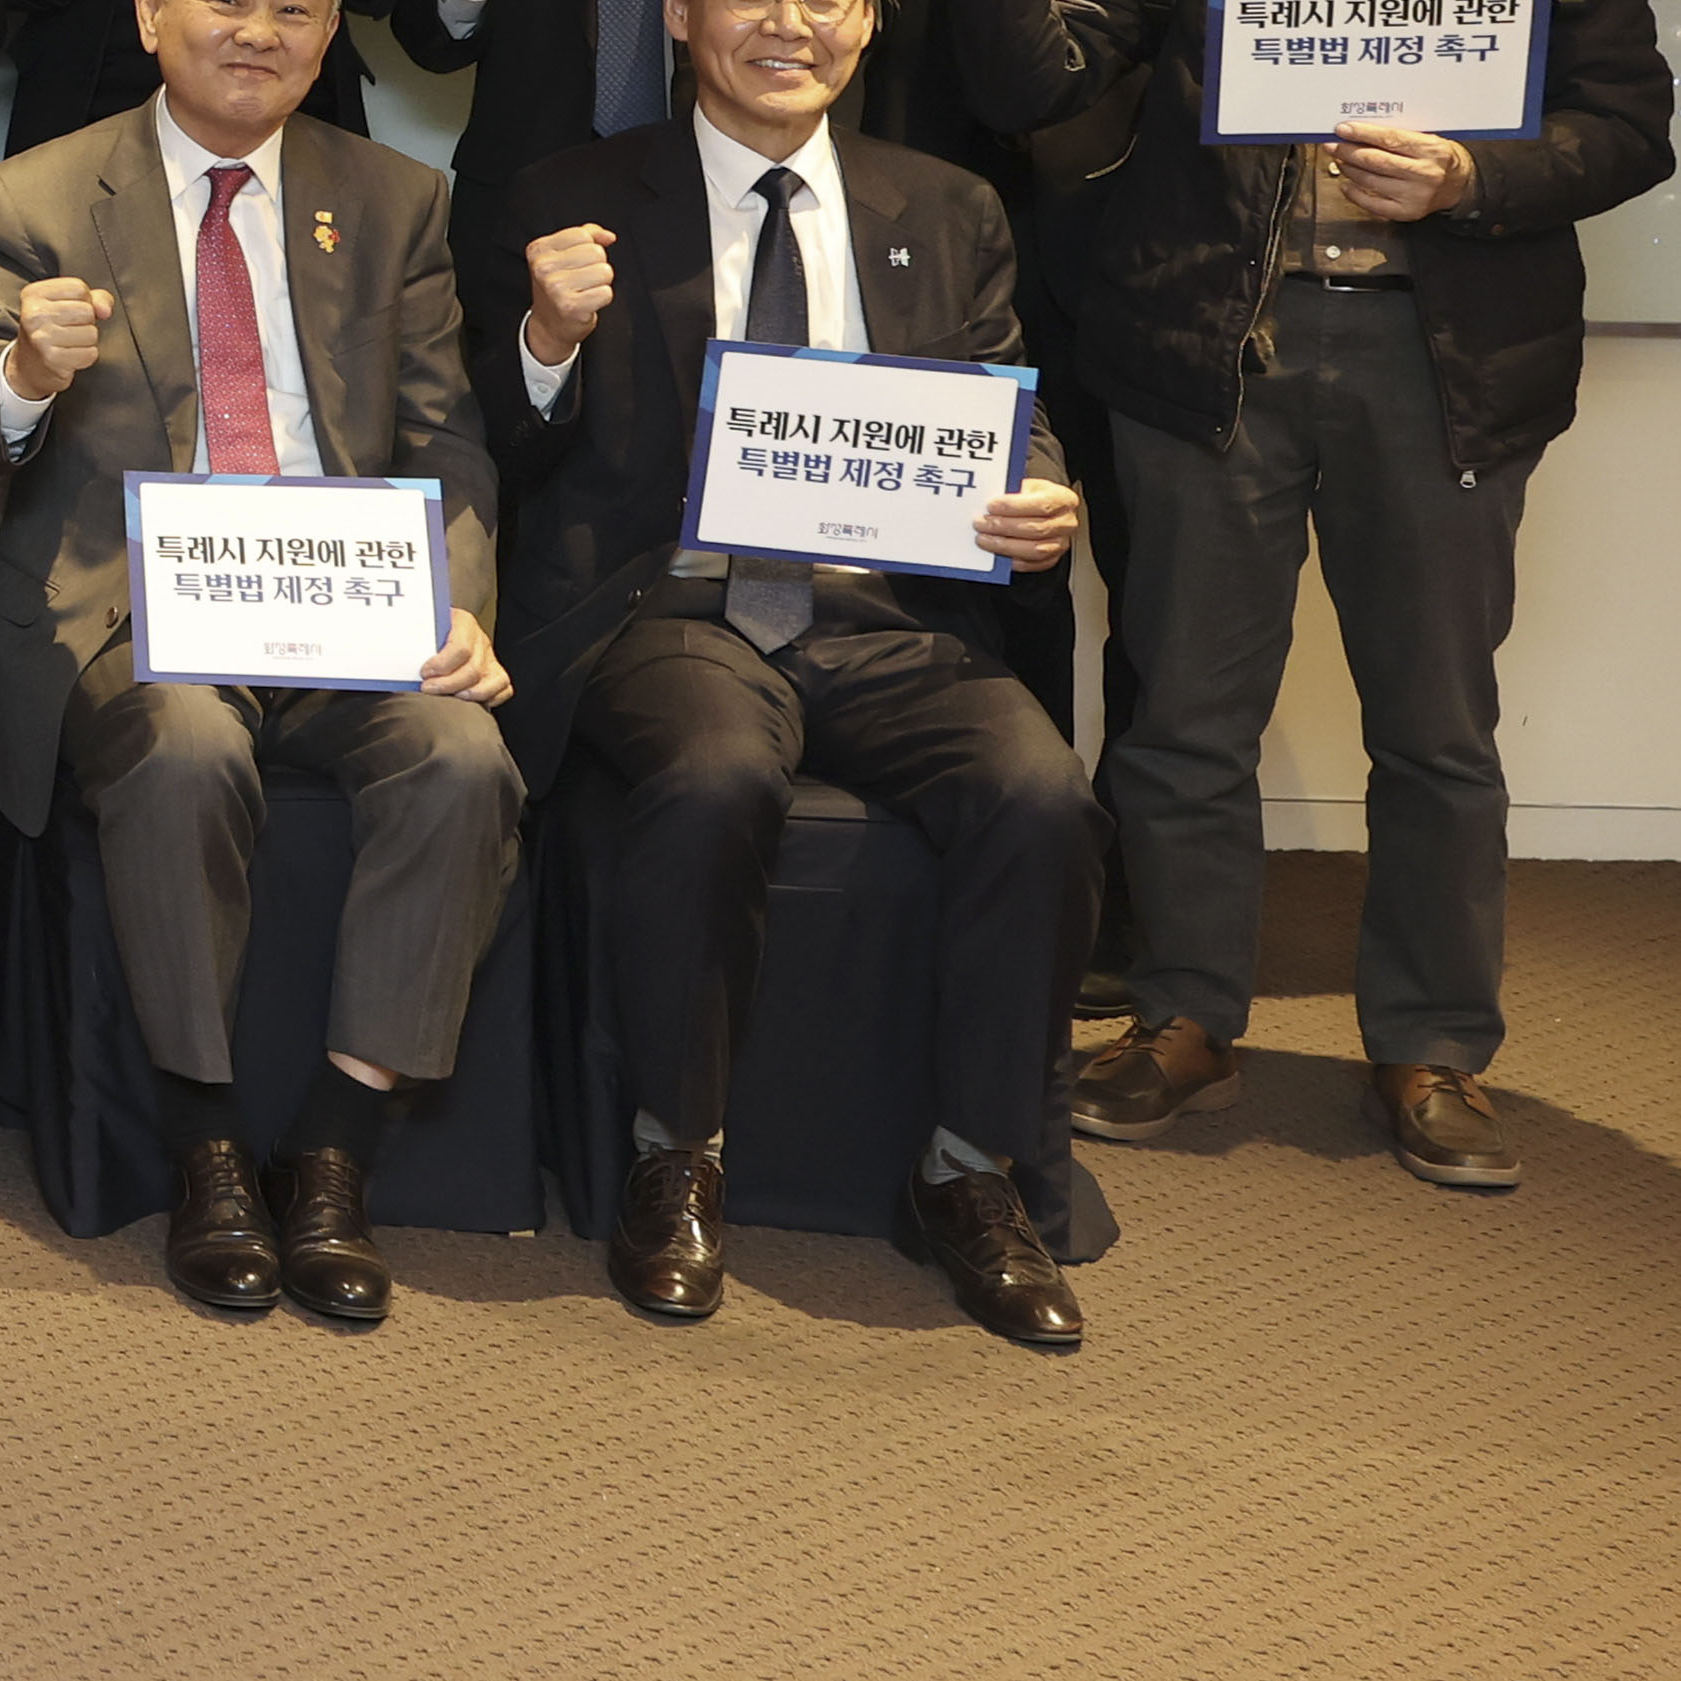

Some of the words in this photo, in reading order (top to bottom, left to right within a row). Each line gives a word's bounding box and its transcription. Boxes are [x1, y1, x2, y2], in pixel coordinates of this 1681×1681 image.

[1237, 0, 1334, 28] 특례시
[1251, 37, 1348, 65] 특별법
[1358, 36, 1423, 65] 제정
[1434, 35, 1499, 62] 촉구
[727, 407, 821, 444] 특례시
[830, 419, 925, 454] 지원에
[934, 428, 998, 461] 관한
[737, 447, 832, 483] 특별법
[839, 458, 904, 491] 제정
[913, 465, 976, 497] 촉구
[156, 536, 245, 564] 특례시
[256, 538, 345, 567] 지원에
[356, 541, 416, 569] 관한
[174, 574, 263, 602] 특별법
[273, 576, 333, 605] 제정
[344, 577, 404, 607] 촉구
